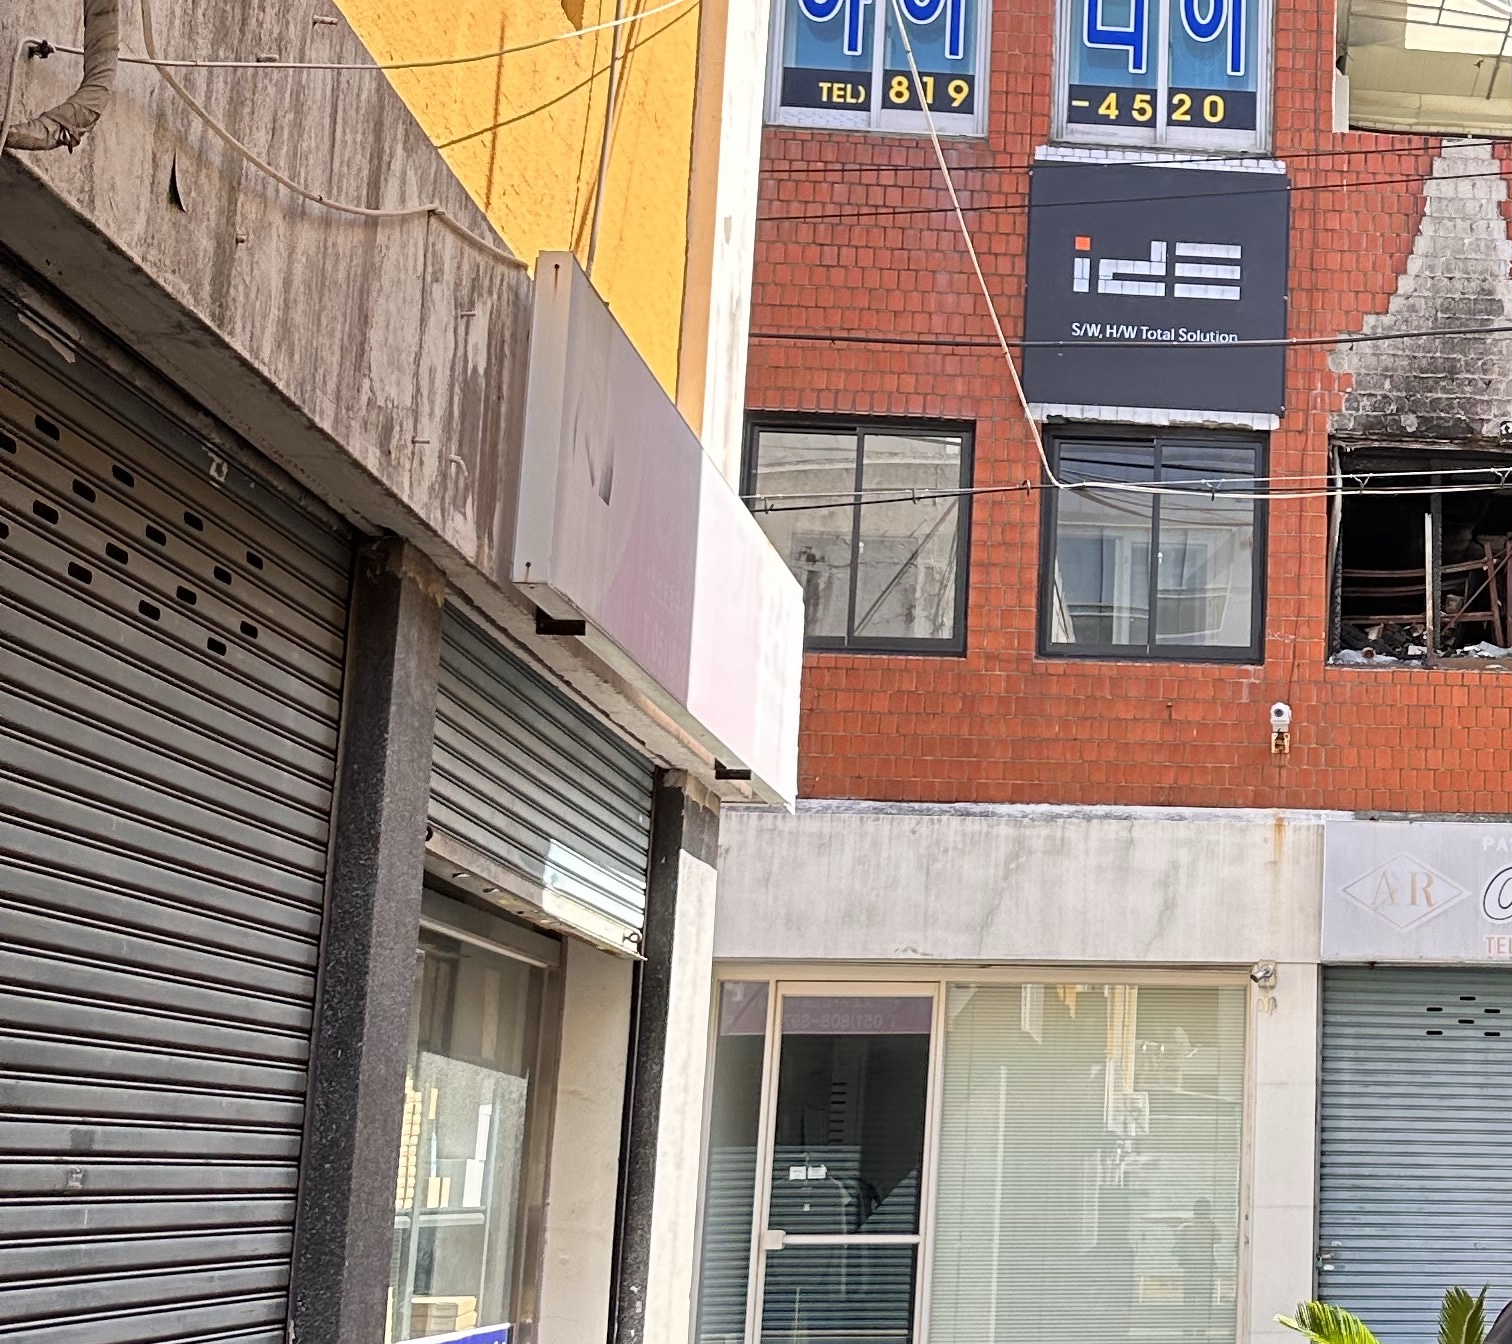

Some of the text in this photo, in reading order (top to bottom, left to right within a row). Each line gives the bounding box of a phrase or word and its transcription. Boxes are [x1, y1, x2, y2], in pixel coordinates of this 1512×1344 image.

[818, 81, 866, 104] TEL)
[1071, 322, 1239, 344] S/W, H/W Total Solution
